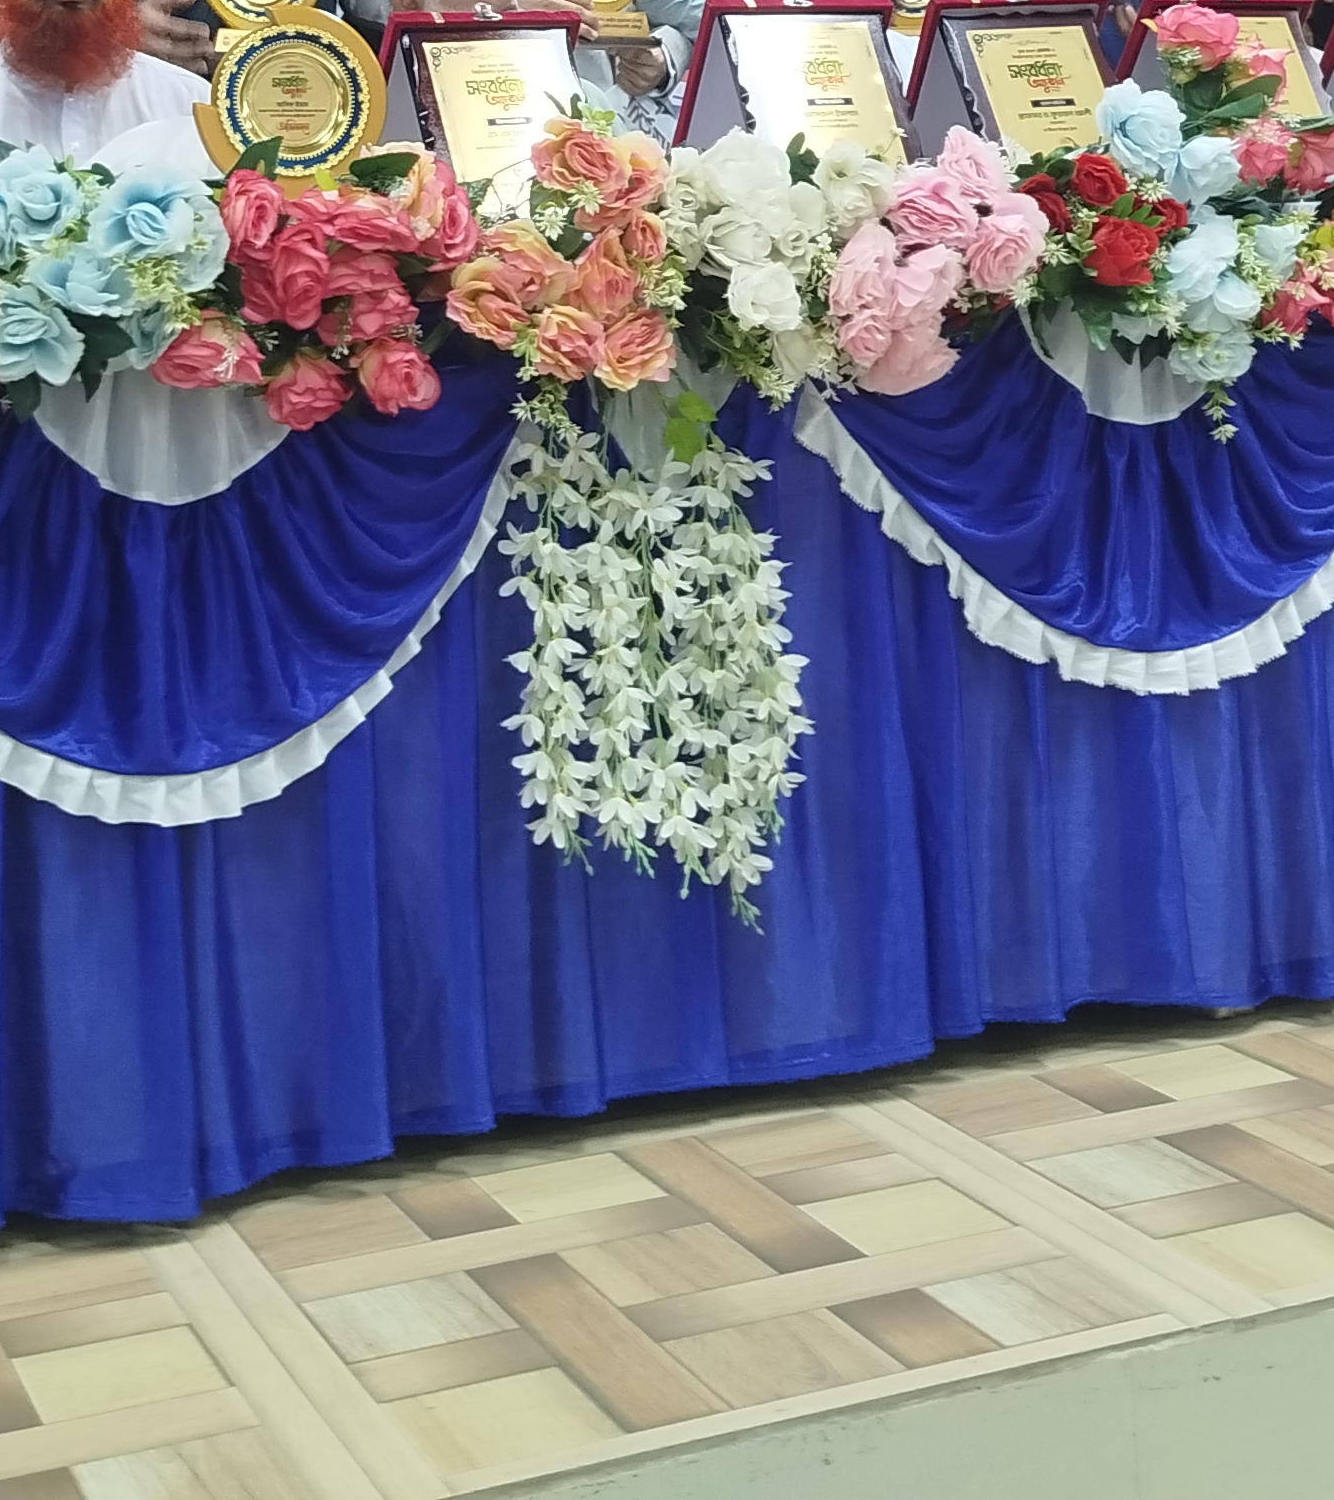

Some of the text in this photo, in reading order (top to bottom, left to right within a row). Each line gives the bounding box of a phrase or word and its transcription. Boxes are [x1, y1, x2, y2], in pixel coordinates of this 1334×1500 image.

[800, 57, 844, 74] ংবর্ধনা
[1007, 59, 1063, 78] সংবর্ধনা
[465, 75, 525, 95] সংবর্ধনা
